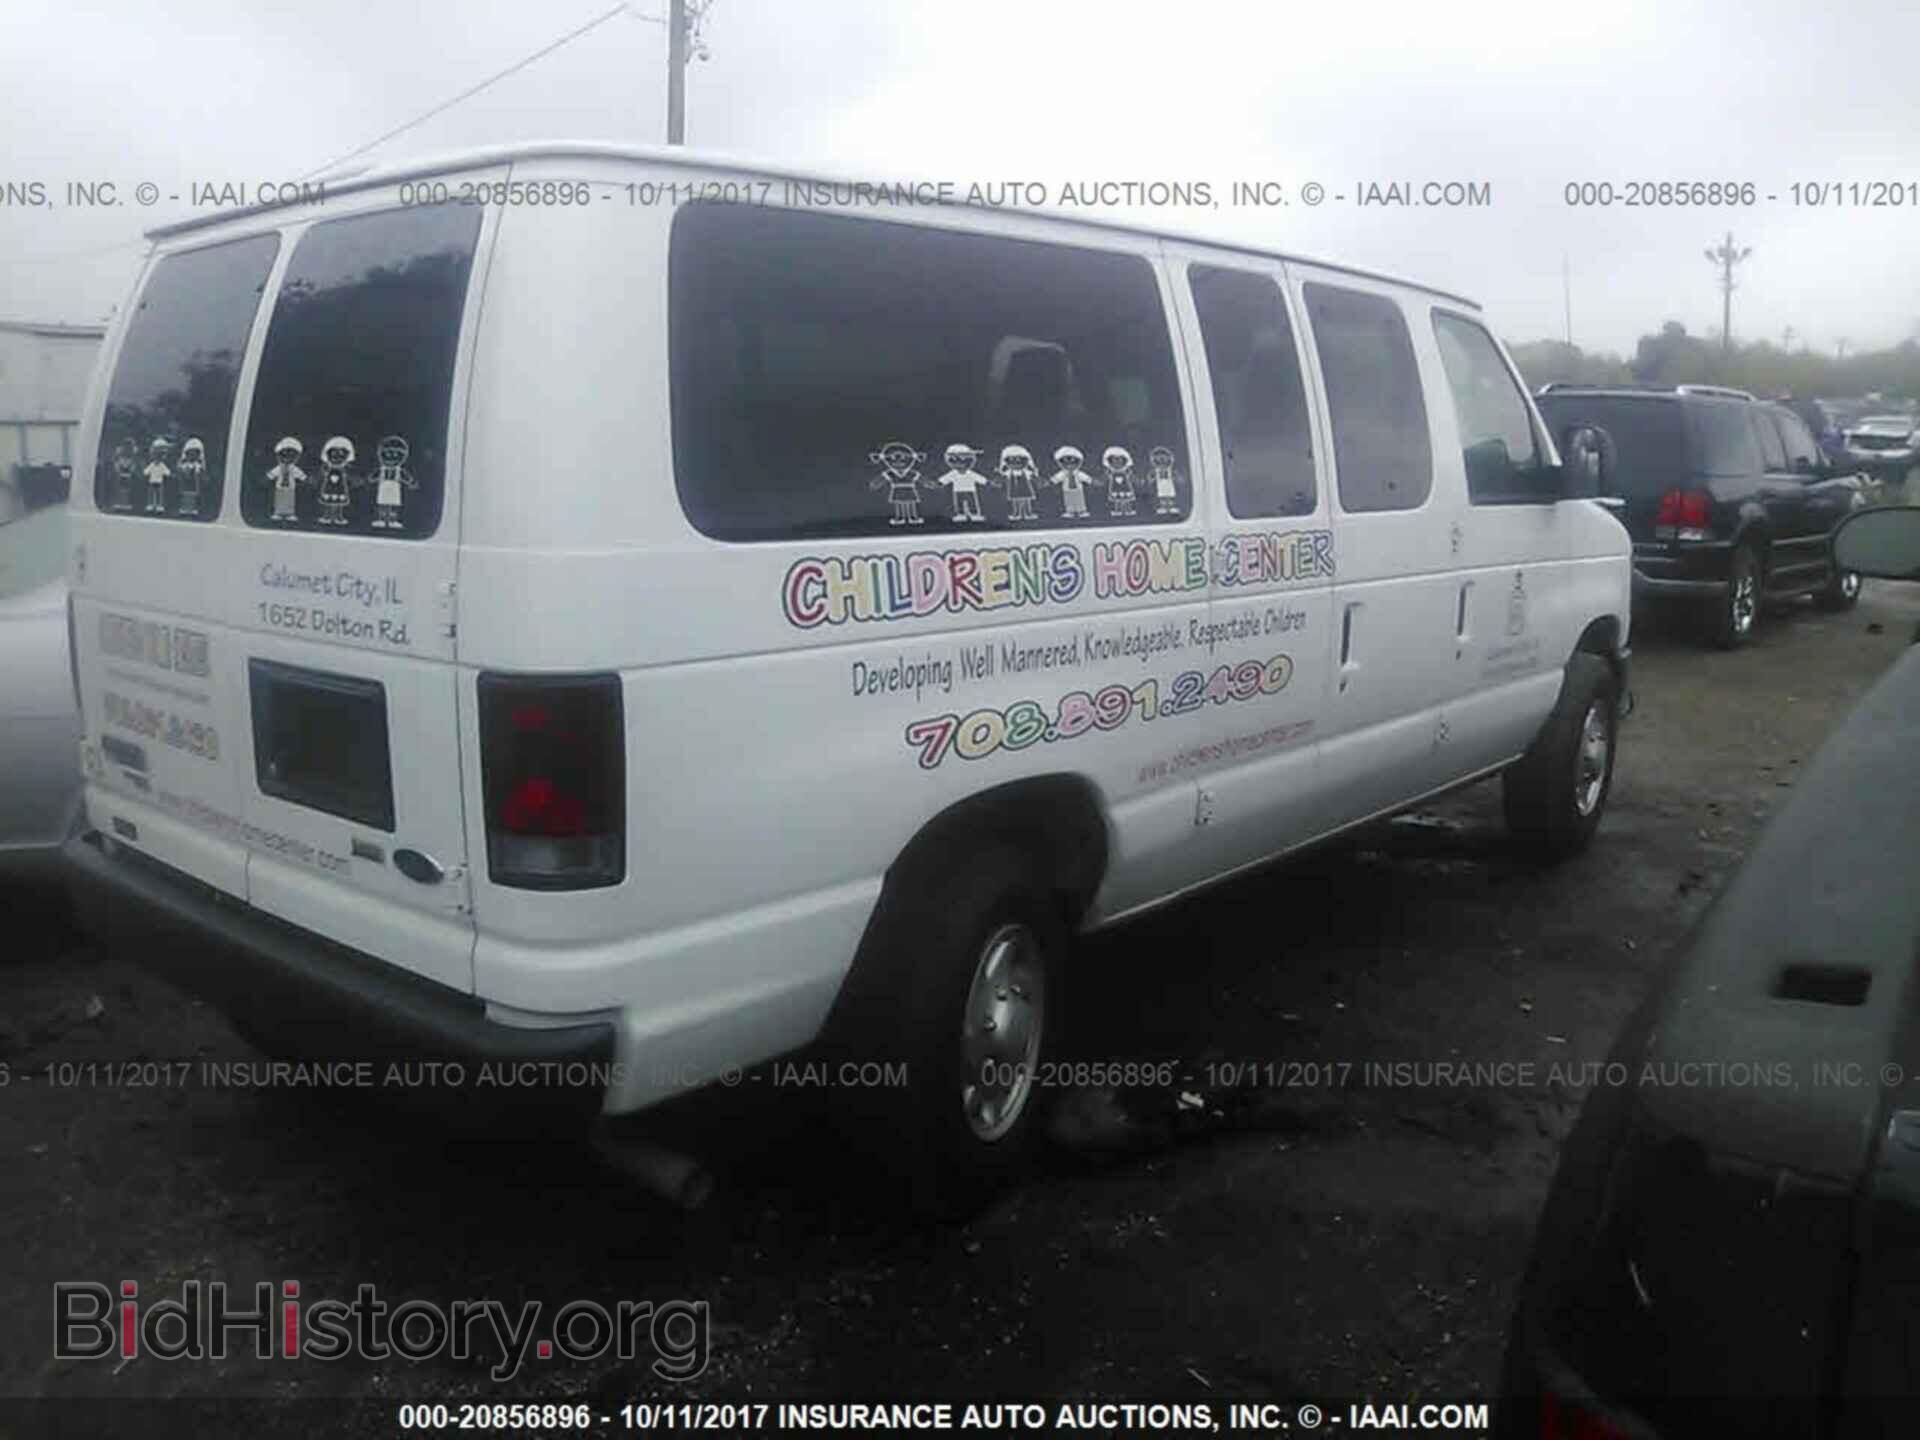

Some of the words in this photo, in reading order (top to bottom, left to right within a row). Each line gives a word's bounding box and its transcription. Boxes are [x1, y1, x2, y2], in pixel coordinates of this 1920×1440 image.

[258, 601, 308, 629] 1652
[311, 608, 375, 639] Dolton
[378, 618, 412, 645] Rd.
[259, 562, 333, 595] Calumet
[384, 575, 404, 605] IL
[782, 543, 1085, 628] CHILDREN'S
[1093, 538, 1205, 598] HOME
[1214, 530, 1335, 587] CENTER
[852, 655, 953, 700] Developing
[960, 646, 994, 679] Well
[1001, 637, 1082, 674] Mannered,
[1189, 610, 1262, 654] Respectable
[1263, 606, 1308, 636] Children
[906, 653, 1295, 769] 708.891.2490
